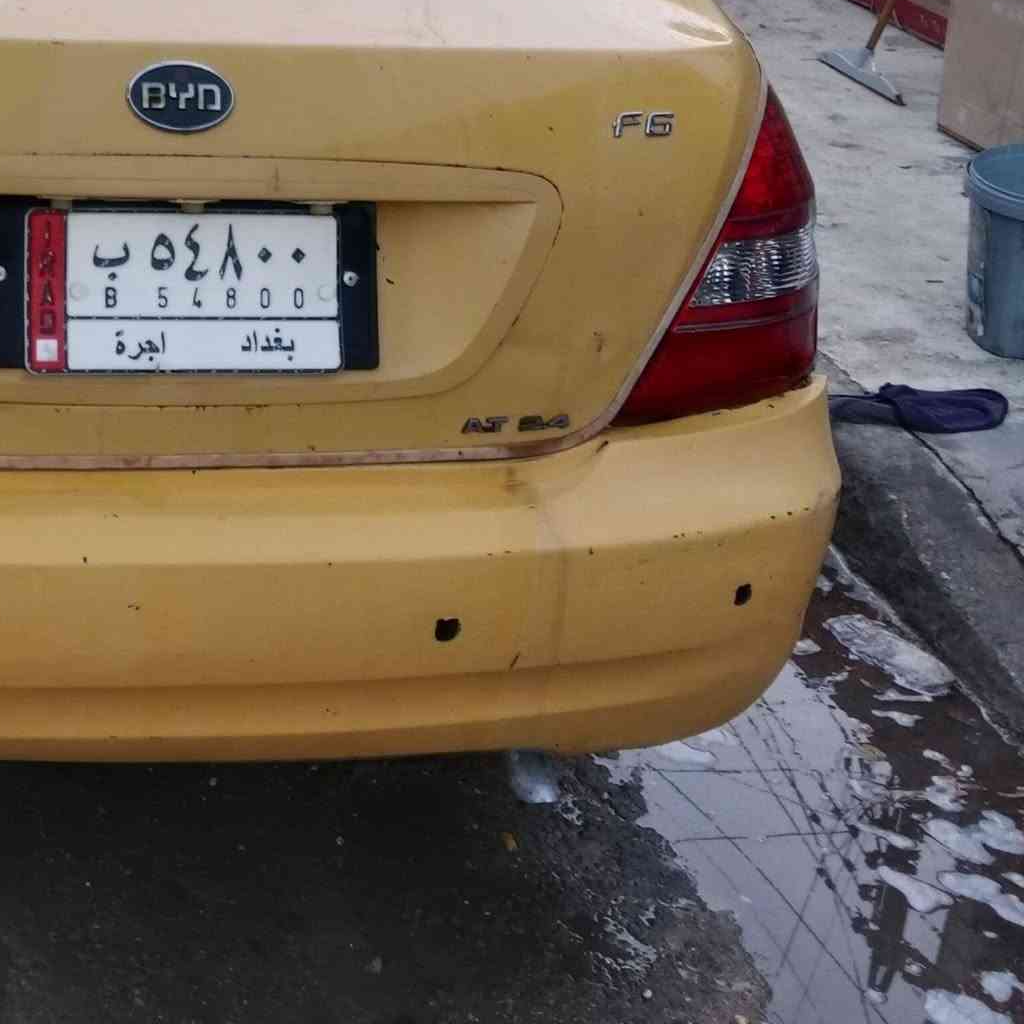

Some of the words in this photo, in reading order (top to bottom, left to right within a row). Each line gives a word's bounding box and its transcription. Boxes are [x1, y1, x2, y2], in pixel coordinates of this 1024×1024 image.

[141, 81, 221, 111] BYD
[92, 242, 130, 282] ب
[150, 223, 306, 282] ٥٤٨٠٠
[104, 287, 118, 309] B
[157, 287, 306, 309] 54800
[241, 329, 296, 362] بغداد
